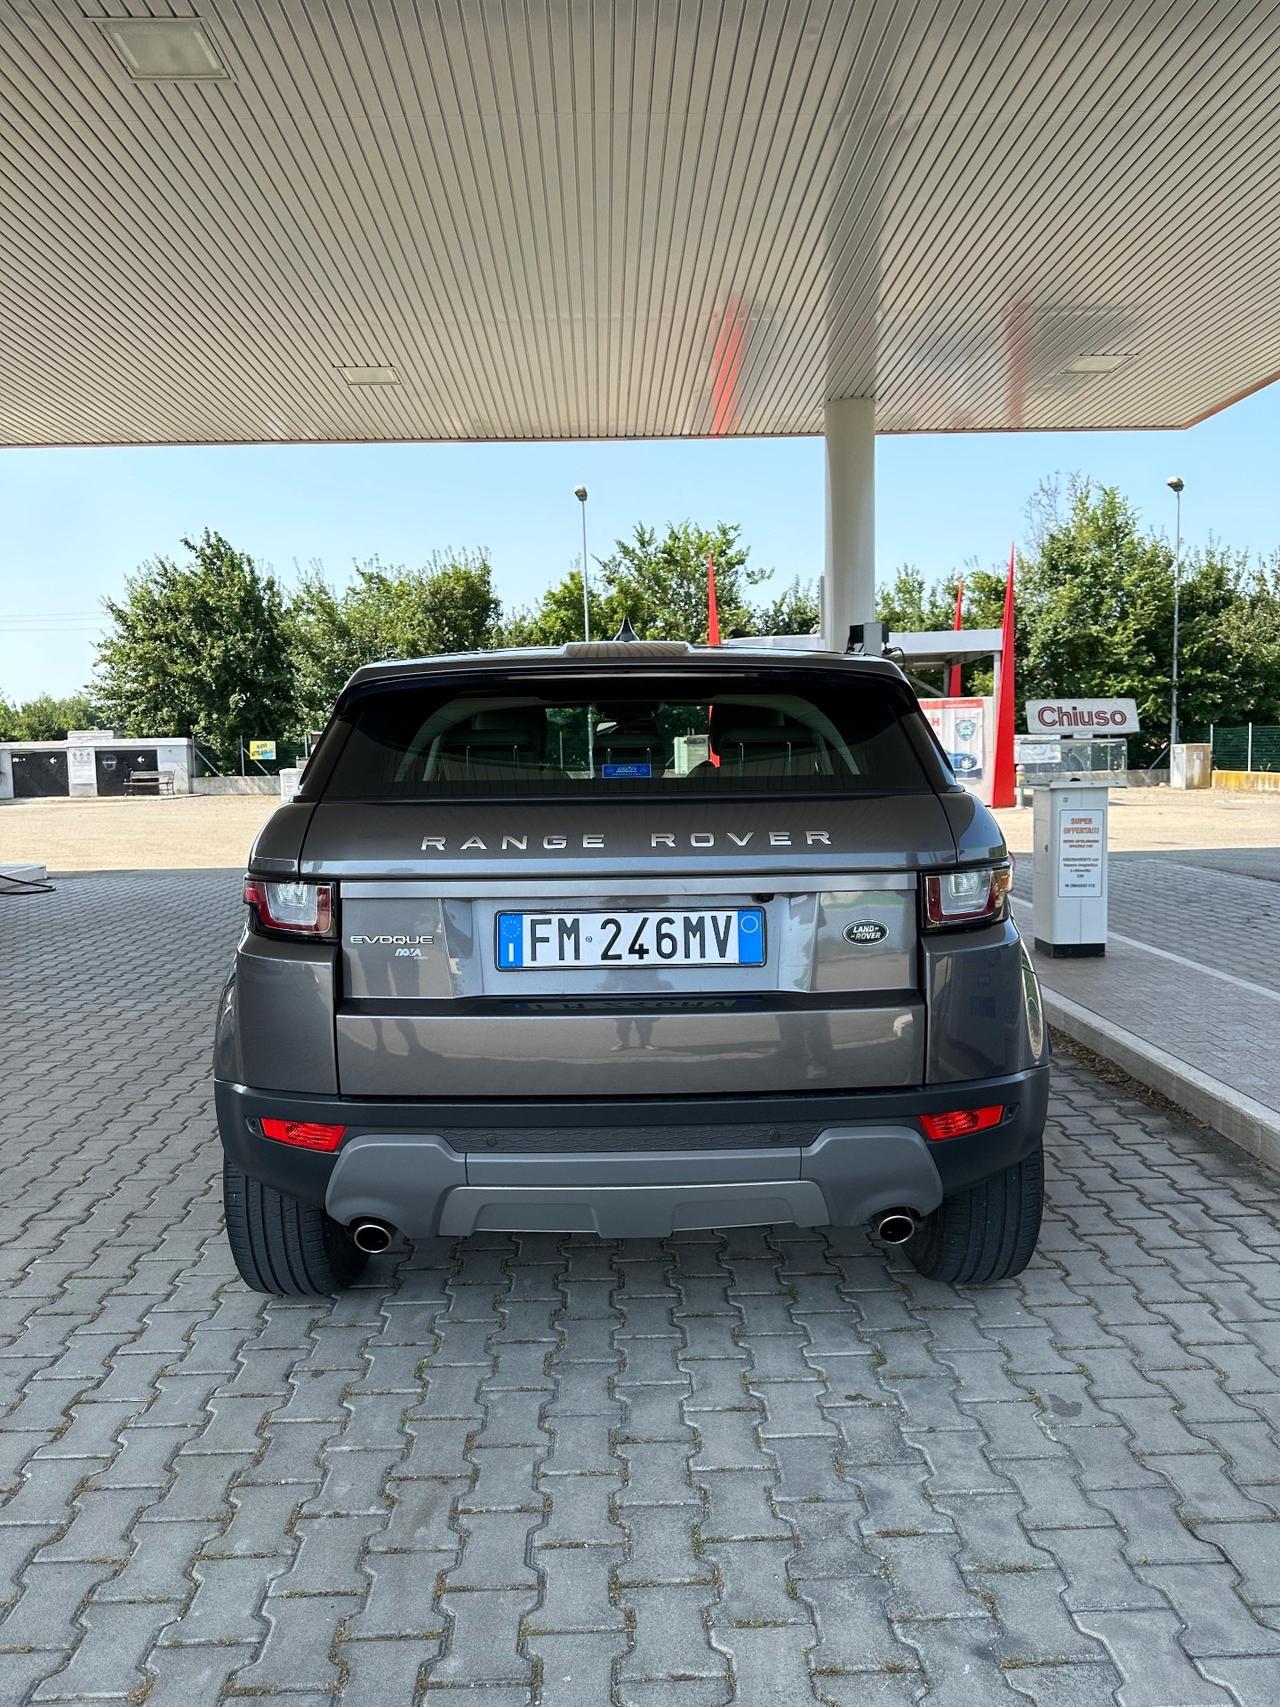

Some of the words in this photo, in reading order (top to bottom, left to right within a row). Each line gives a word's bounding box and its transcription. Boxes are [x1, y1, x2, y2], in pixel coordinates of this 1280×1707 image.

[1038, 706, 1127, 727] Chiuso
[1071, 817, 1093, 825] SUPER
[420, 834, 605, 851] RANGE
[650, 830, 832, 848] ROVER
[350, 935, 434, 944] EVOQUE
[530, 917, 580, 962] FM
[600, 915, 733, 961] 246MV
[508, 942, 515, 962] I
